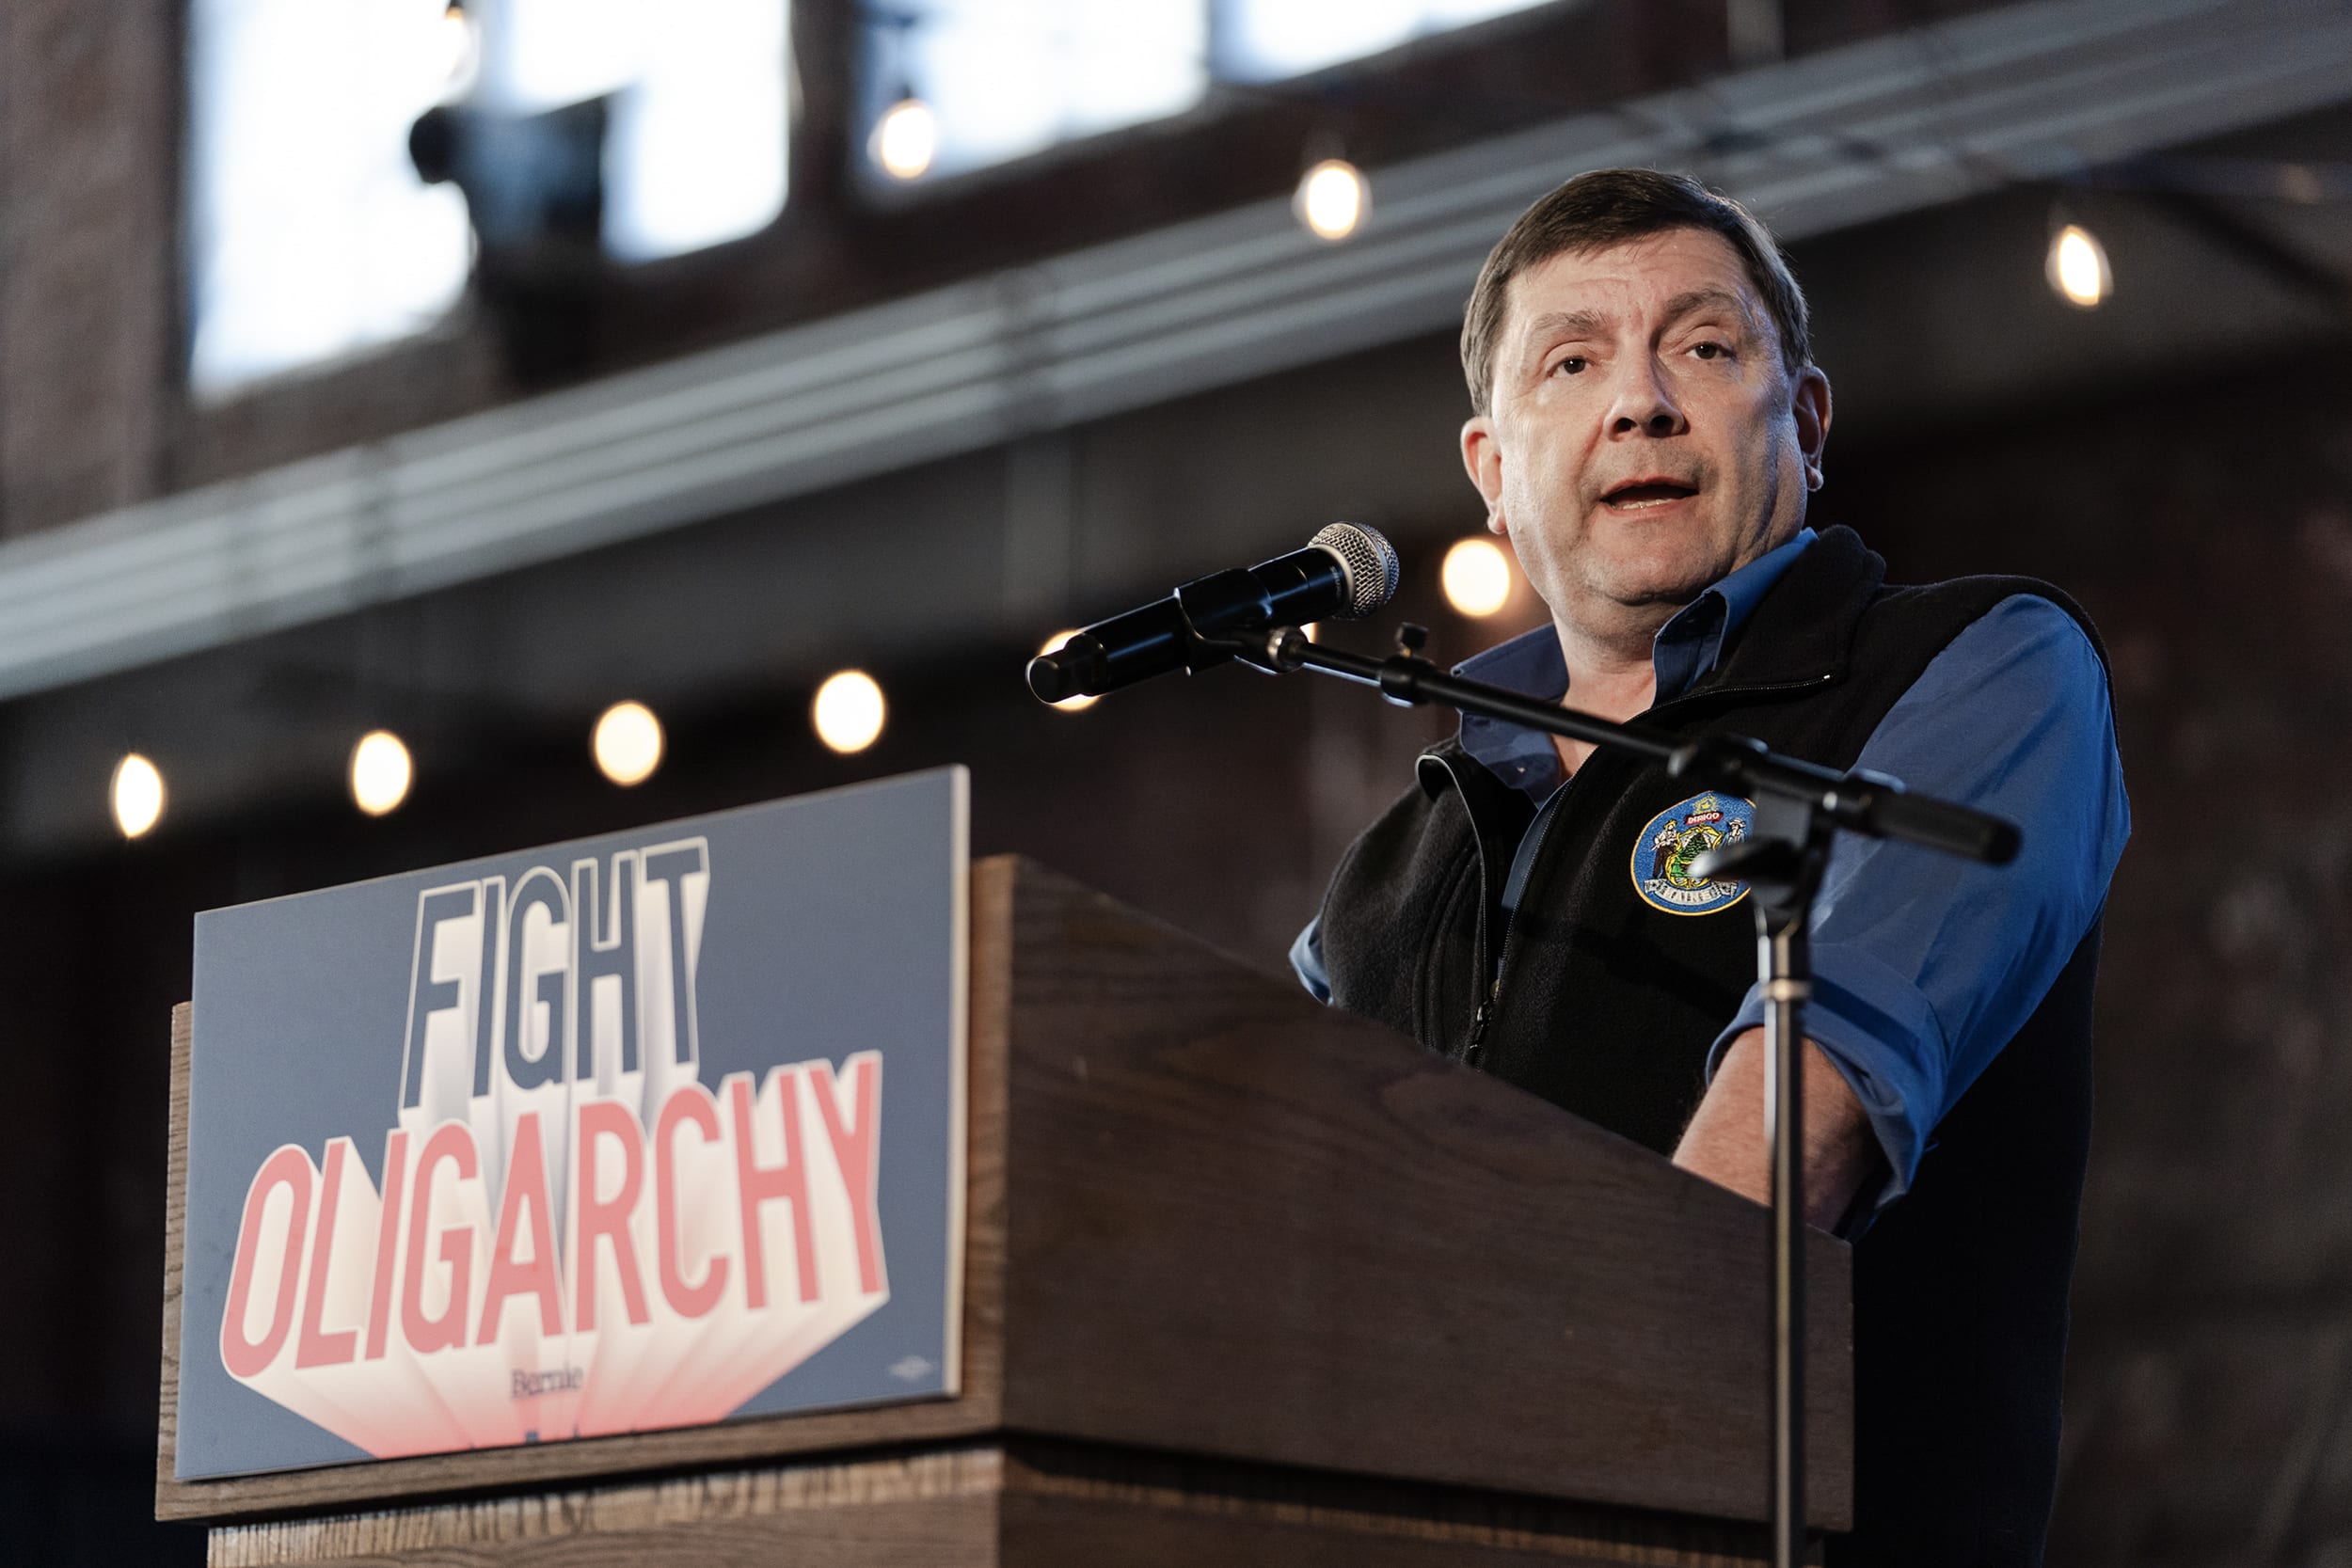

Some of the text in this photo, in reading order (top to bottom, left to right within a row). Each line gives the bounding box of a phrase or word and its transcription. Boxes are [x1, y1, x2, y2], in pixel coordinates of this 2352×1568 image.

[1687, 812, 1720, 824] DIRIGO
[399, 836, 710, 1112] FIGHT
[221, 1053, 886, 1379] OLIGARCHY
[511, 1365, 584, 1400] Bernie
